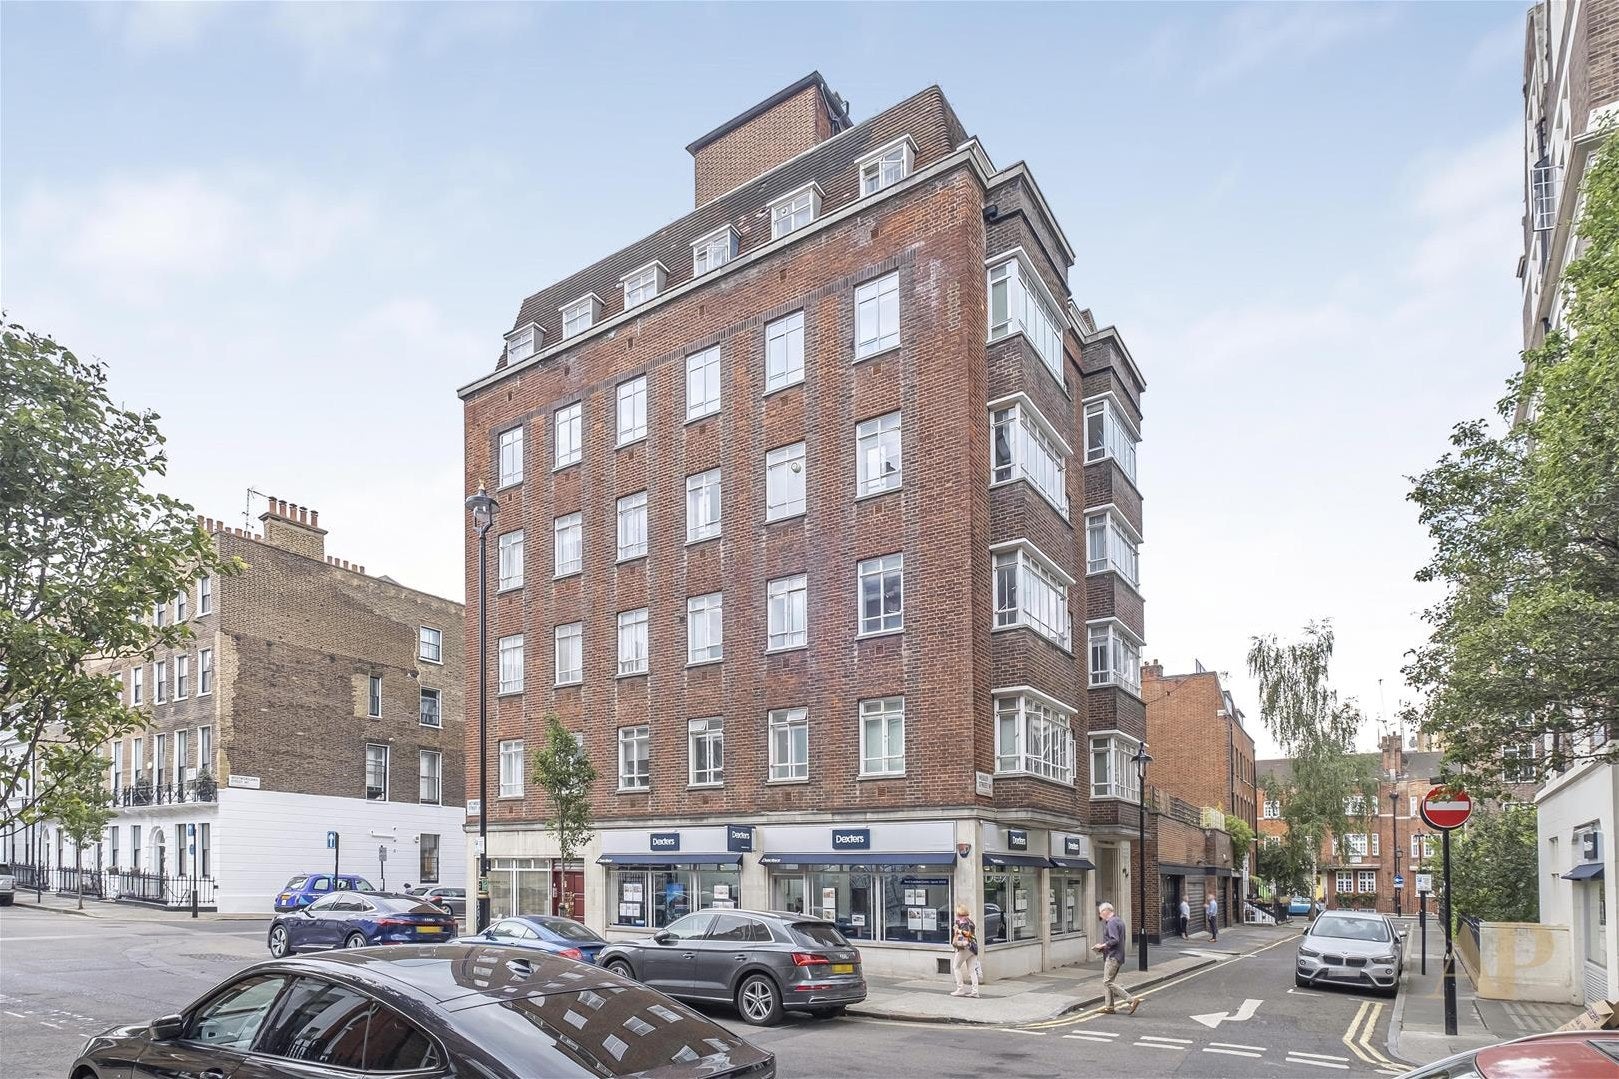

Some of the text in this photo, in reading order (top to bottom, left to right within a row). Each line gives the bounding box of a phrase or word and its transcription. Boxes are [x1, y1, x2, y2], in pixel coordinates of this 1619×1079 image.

[731, 830, 750, 840] Dexters
[835, 834, 865, 844] Dexters
[652, 837, 676, 846] Dexters
